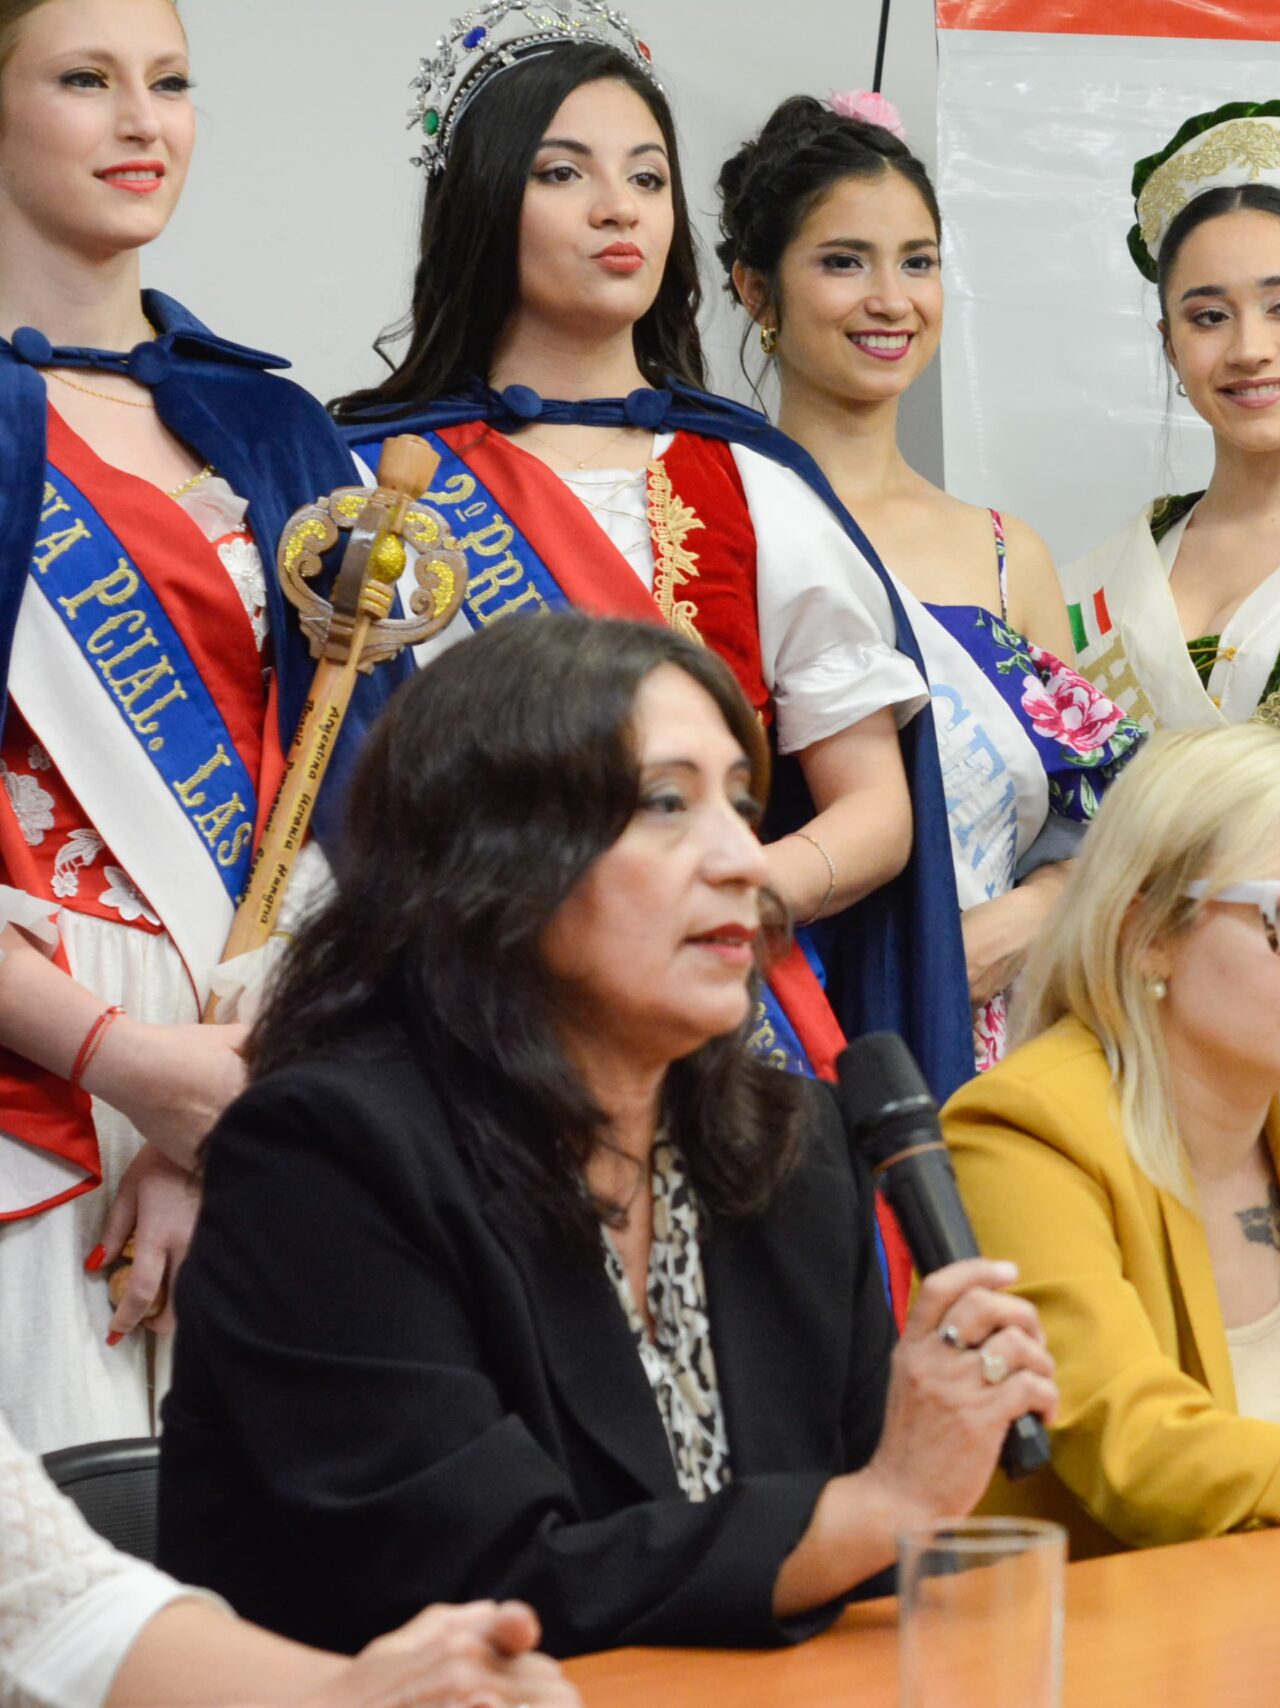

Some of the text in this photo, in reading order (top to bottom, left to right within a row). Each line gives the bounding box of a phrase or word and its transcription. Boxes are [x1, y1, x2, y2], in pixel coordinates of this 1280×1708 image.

[456, 513, 550, 624] PRI
[57, 556, 188, 751] PCIAL.
[172, 743, 253, 868] LAS
[308, 704, 340, 780] Argentina
[283, 792, 312, 850] Ucrania
